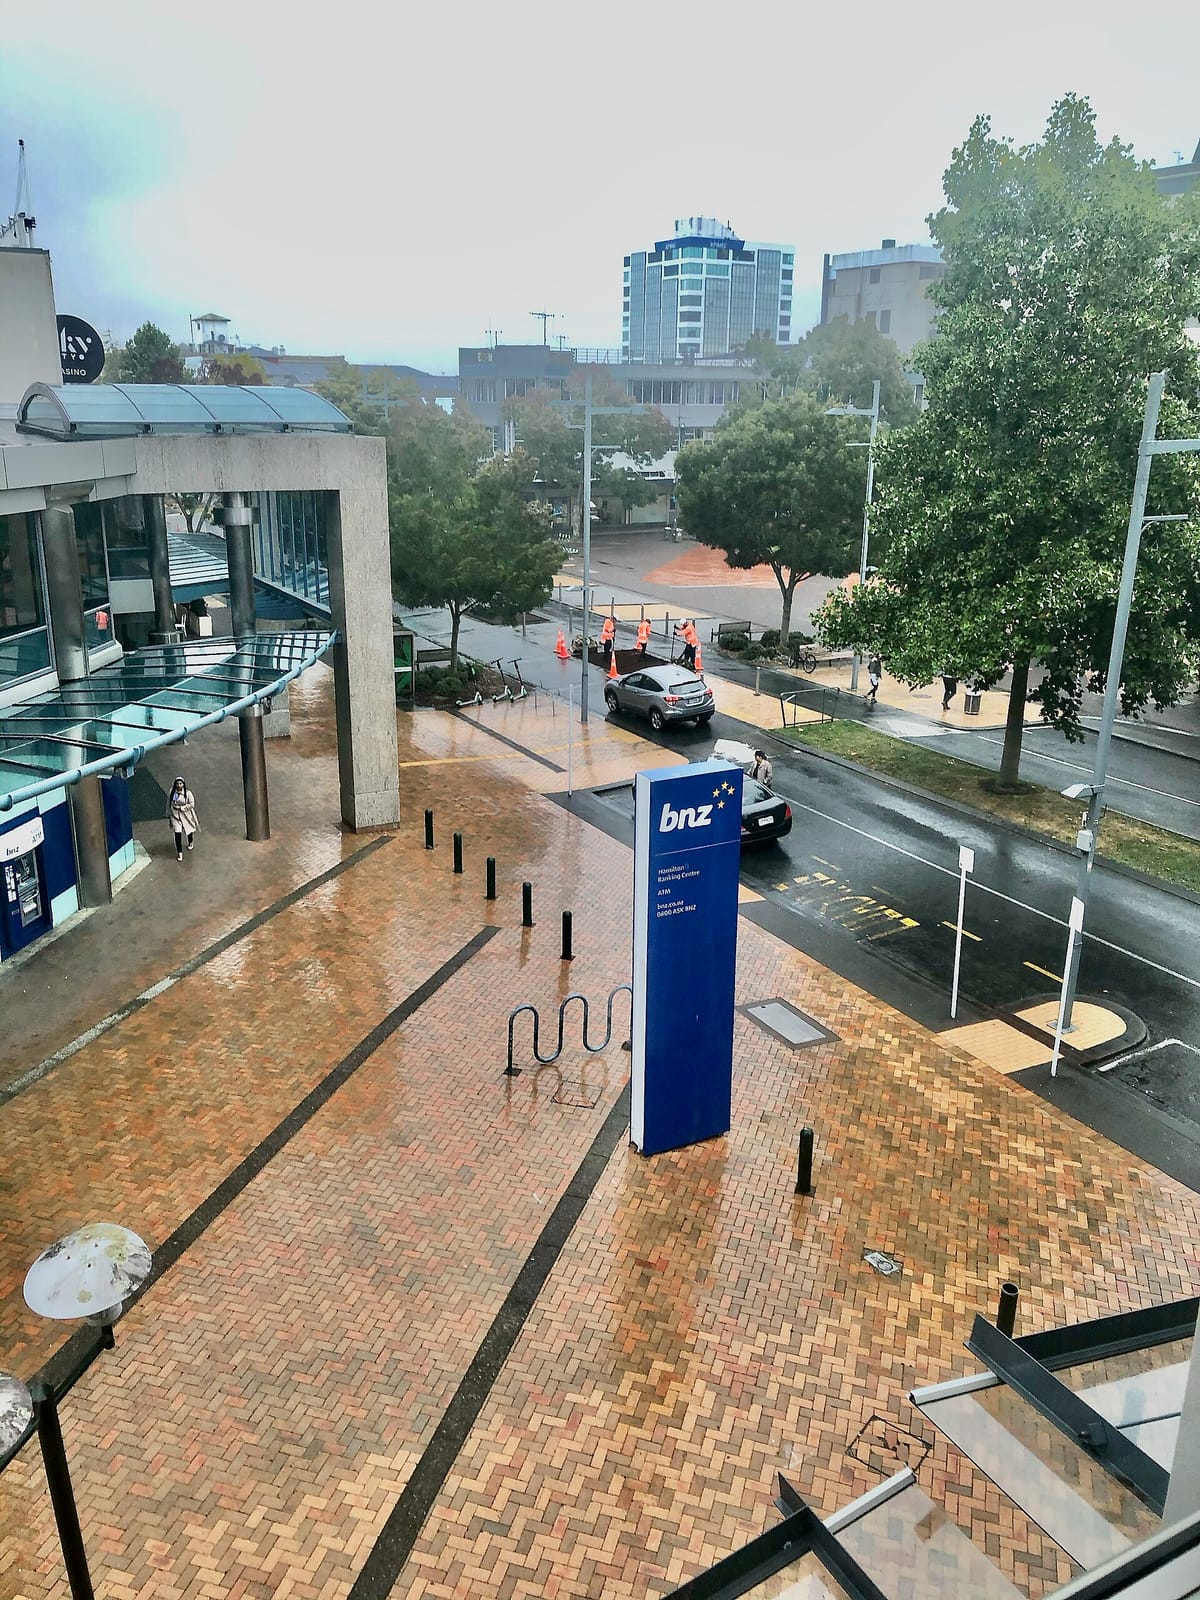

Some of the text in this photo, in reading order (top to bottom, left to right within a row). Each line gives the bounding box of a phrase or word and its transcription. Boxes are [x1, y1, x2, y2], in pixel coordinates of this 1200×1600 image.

[659, 803, 713, 833] bnz
[657, 870, 700, 883] Banking Centre
[658, 865, 685, 875] Hamilton
[657, 888, 671, 896] ATM
[656, 909, 672, 918] 0800
[684, 904, 697, 912] BNZ
